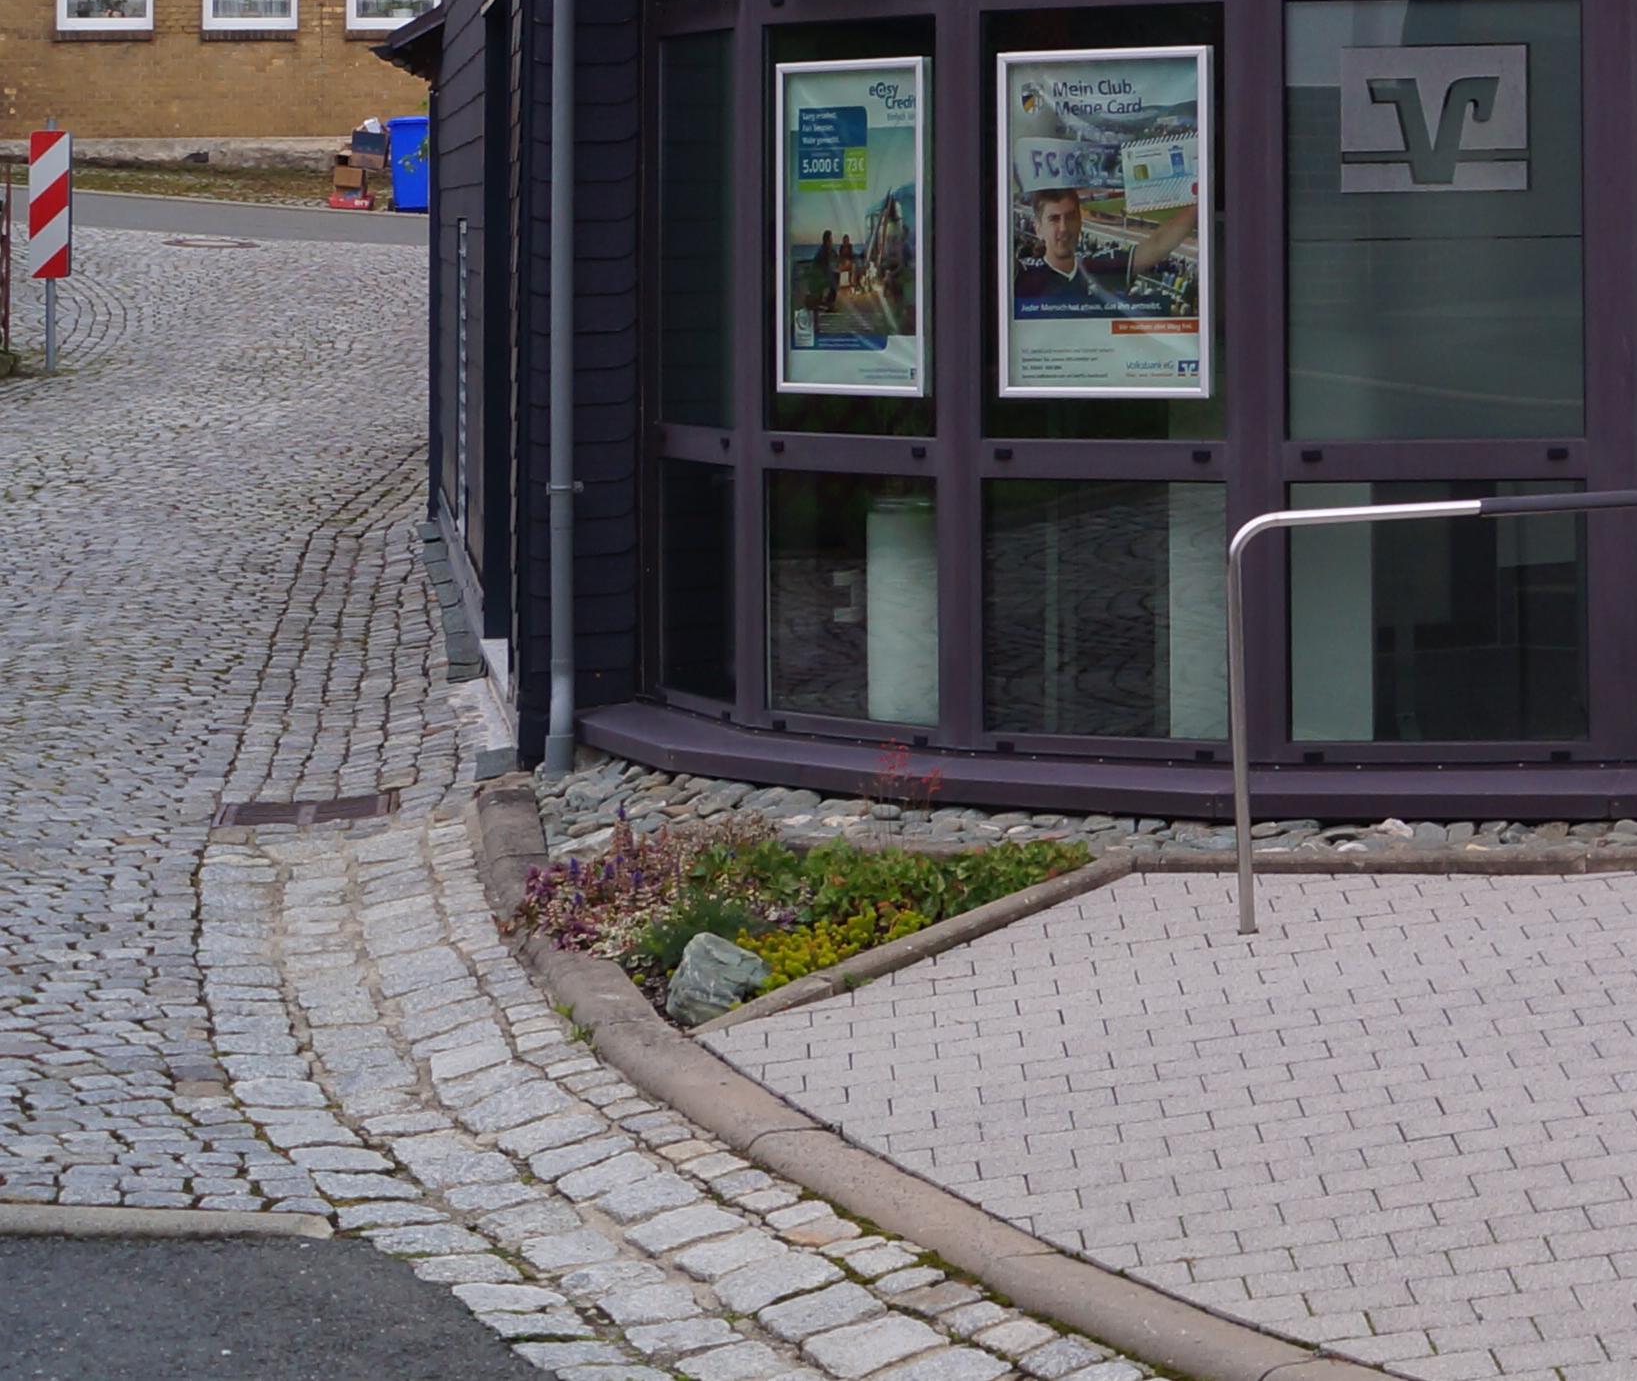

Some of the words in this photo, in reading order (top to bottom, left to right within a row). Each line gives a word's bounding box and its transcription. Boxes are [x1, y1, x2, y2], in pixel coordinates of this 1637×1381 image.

[1052, 80, 1093, 97] Mein
[1098, 79, 1137, 96] Club.
[885, 95, 916, 109] Credi
[1054, 99, 1102, 116] Meine
[802, 159, 832, 173] 5.000
[833, 158, 840, 172] €
[1031, 150, 1060, 178] FC
